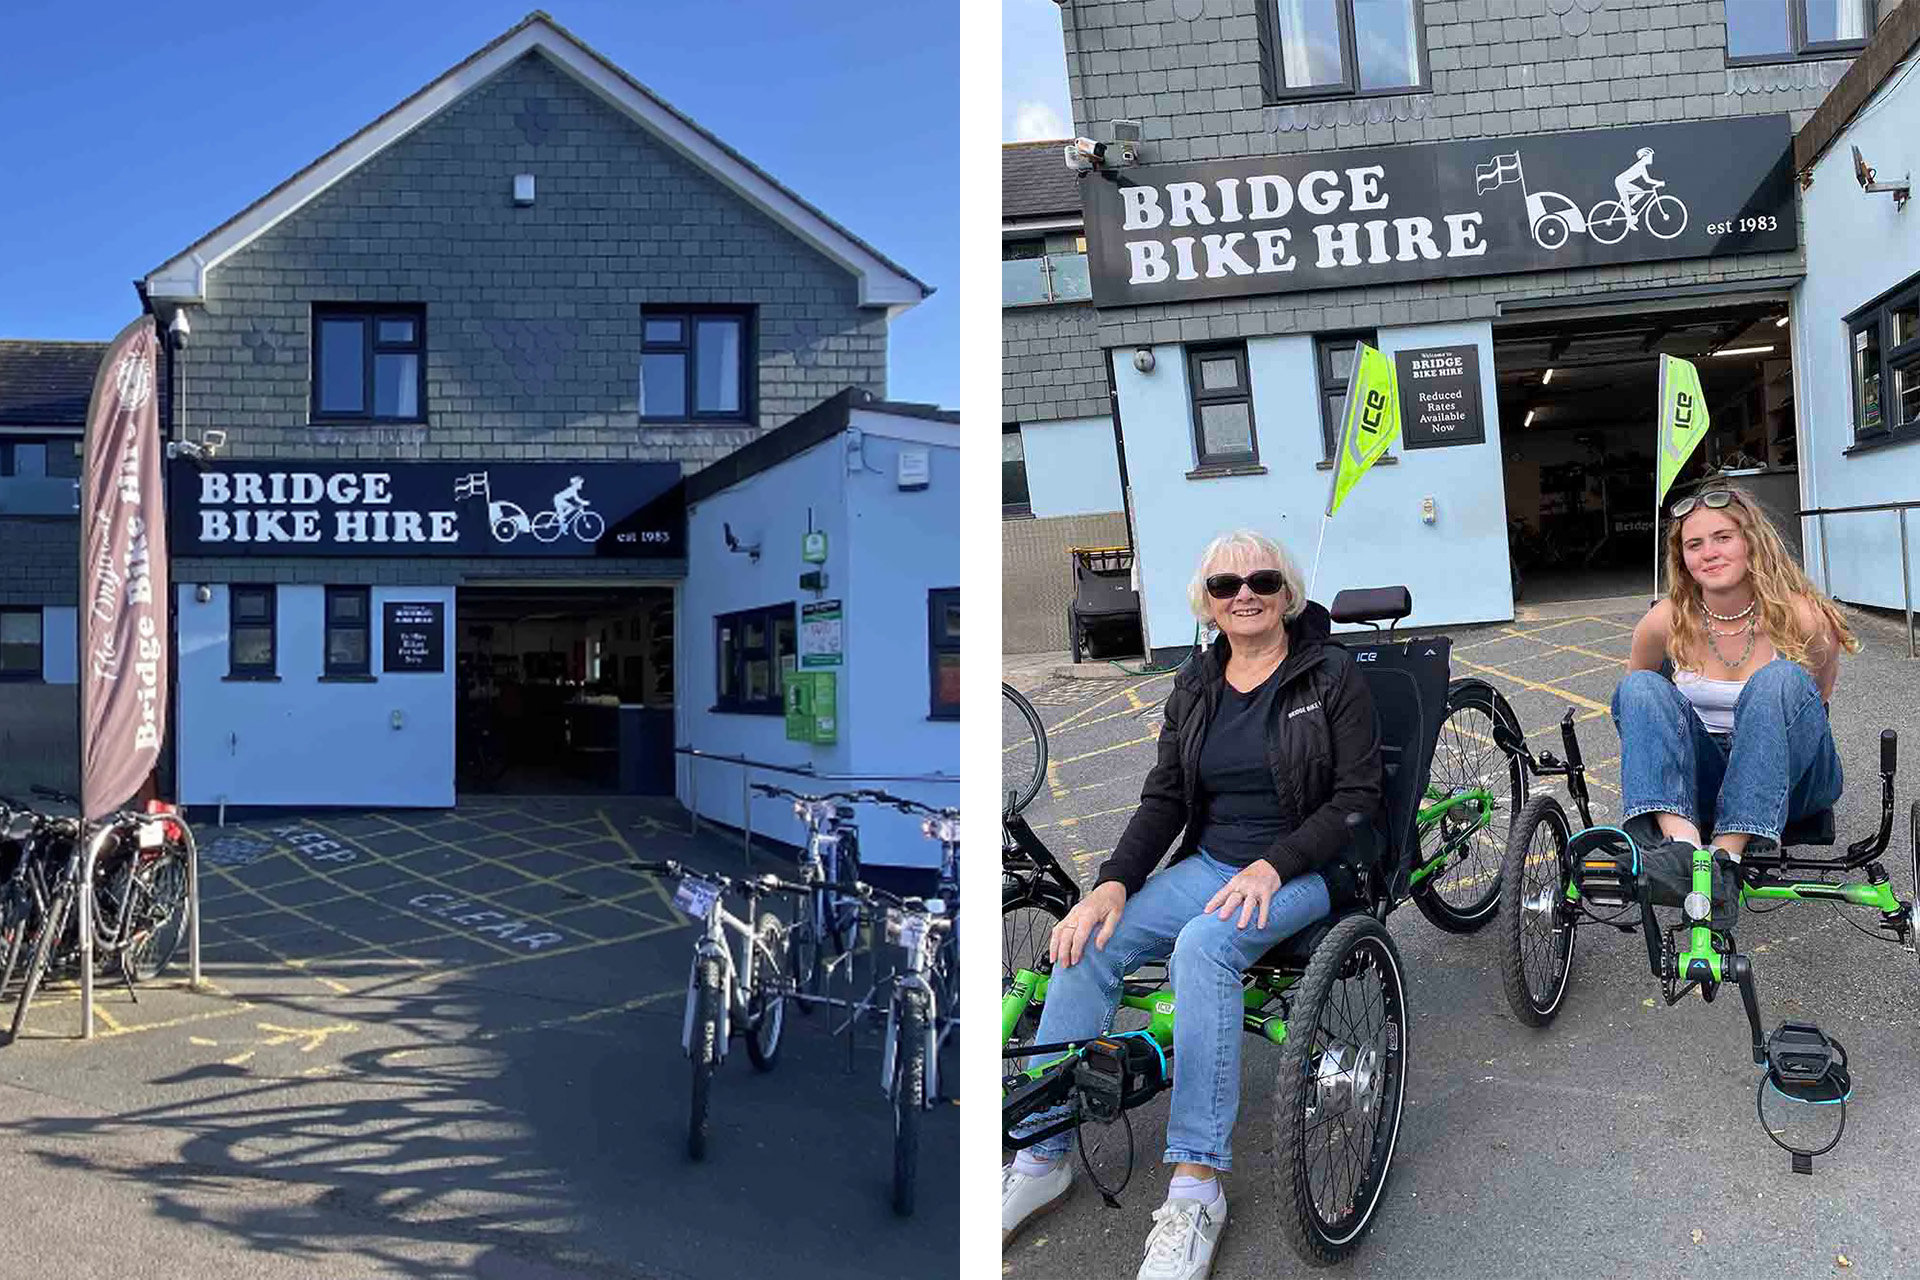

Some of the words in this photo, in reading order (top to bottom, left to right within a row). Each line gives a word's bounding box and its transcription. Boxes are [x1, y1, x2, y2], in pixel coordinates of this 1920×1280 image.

[1118, 165, 1390, 231] BRIDGE
[1707, 220, 1733, 236] est
[1739, 215, 1778, 232] 1983
[1126, 228, 1297, 285] BIKE
[1312, 211, 1488, 269] HIRE
[1411, 357, 1463, 370] BRIDGE
[1413, 369, 1438, 379] BIKE
[1439, 367, 1464, 377] HIRE
[1362, 389, 1386, 436] ICE
[1418, 390, 1463, 402] Reduced
[1428, 402, 1456, 412] Rates
[1674, 392, 1693, 429] ICE
[1419, 411, 1466, 423] Available
[1432, 423, 1456, 433] Now
[198, 472, 393, 505] BRIDGE
[198, 510, 322, 543] BIKE
[334, 510, 460, 543] HIRE
[124, 516, 152, 605] Bike
[93, 633, 118, 680] The
[1356, 652, 1377, 663] ICE
[135, 616, 161, 751] Bridge
[272, 825, 356, 863] KEEP
[408, 893, 563, 949] CLEAR
